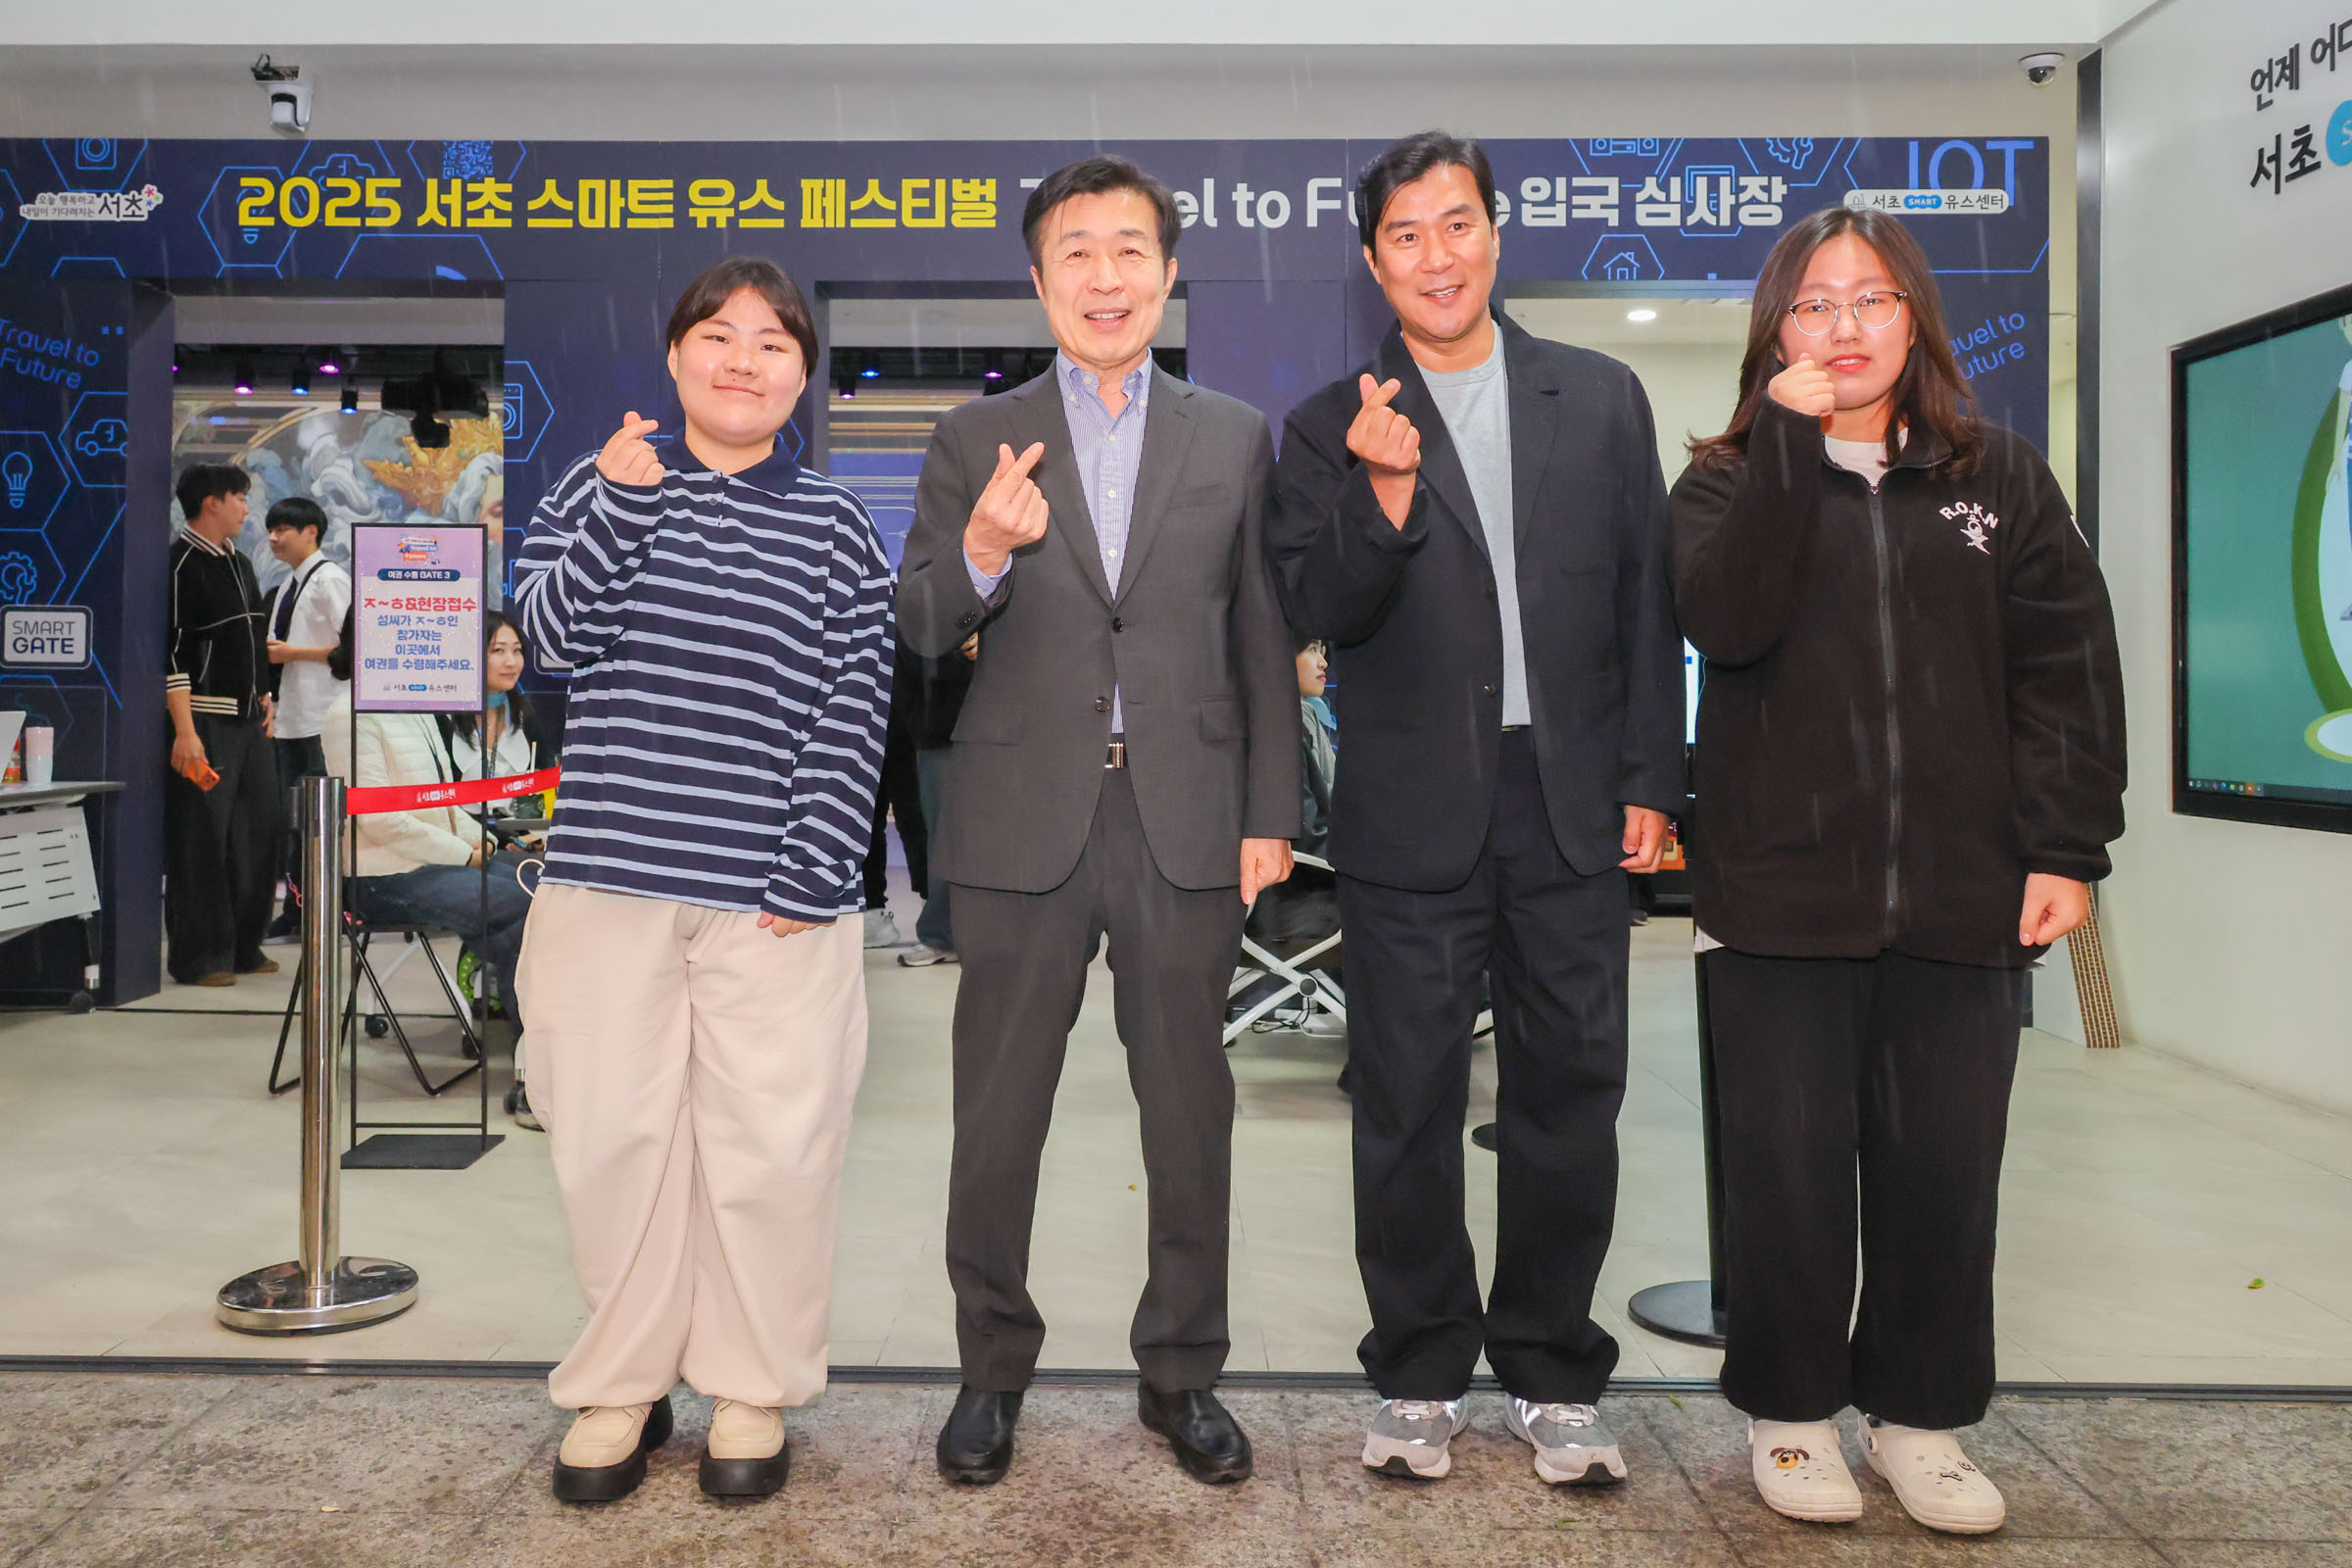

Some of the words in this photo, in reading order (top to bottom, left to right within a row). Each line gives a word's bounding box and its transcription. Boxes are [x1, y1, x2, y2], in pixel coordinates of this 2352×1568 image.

[2250, 43, 2300, 112] 언제
[2250, 123, 2322, 195] 서초
[99, 195, 145, 219] 서초
[238, 176, 402, 227] 2025
[416, 177, 513, 228] 서초
[527, 178, 674, 228] 스마트
[688, 178, 785, 228] 유스
[800, 178, 997, 228] 페스티벌
[1232, 183, 1291, 228] to
[1520, 176, 1619, 227] 입국
[1636, 175, 1788, 226] 심사장
[1873, 194, 1901, 209] 서초
[1944, 194, 2004, 210] 유스센터
[1998, 313, 2026, 334] to
[0, 318, 72, 360] Travel
[76, 344, 100, 367] to
[0, 347, 81, 389] Future
[1958, 341, 2026, 380] uture
[13, 620, 75, 635] SMART
[397, 629, 442, 642] 참가자는
[13, 637, 74, 654] GATE
[395, 644, 441, 656] 이곳에서
